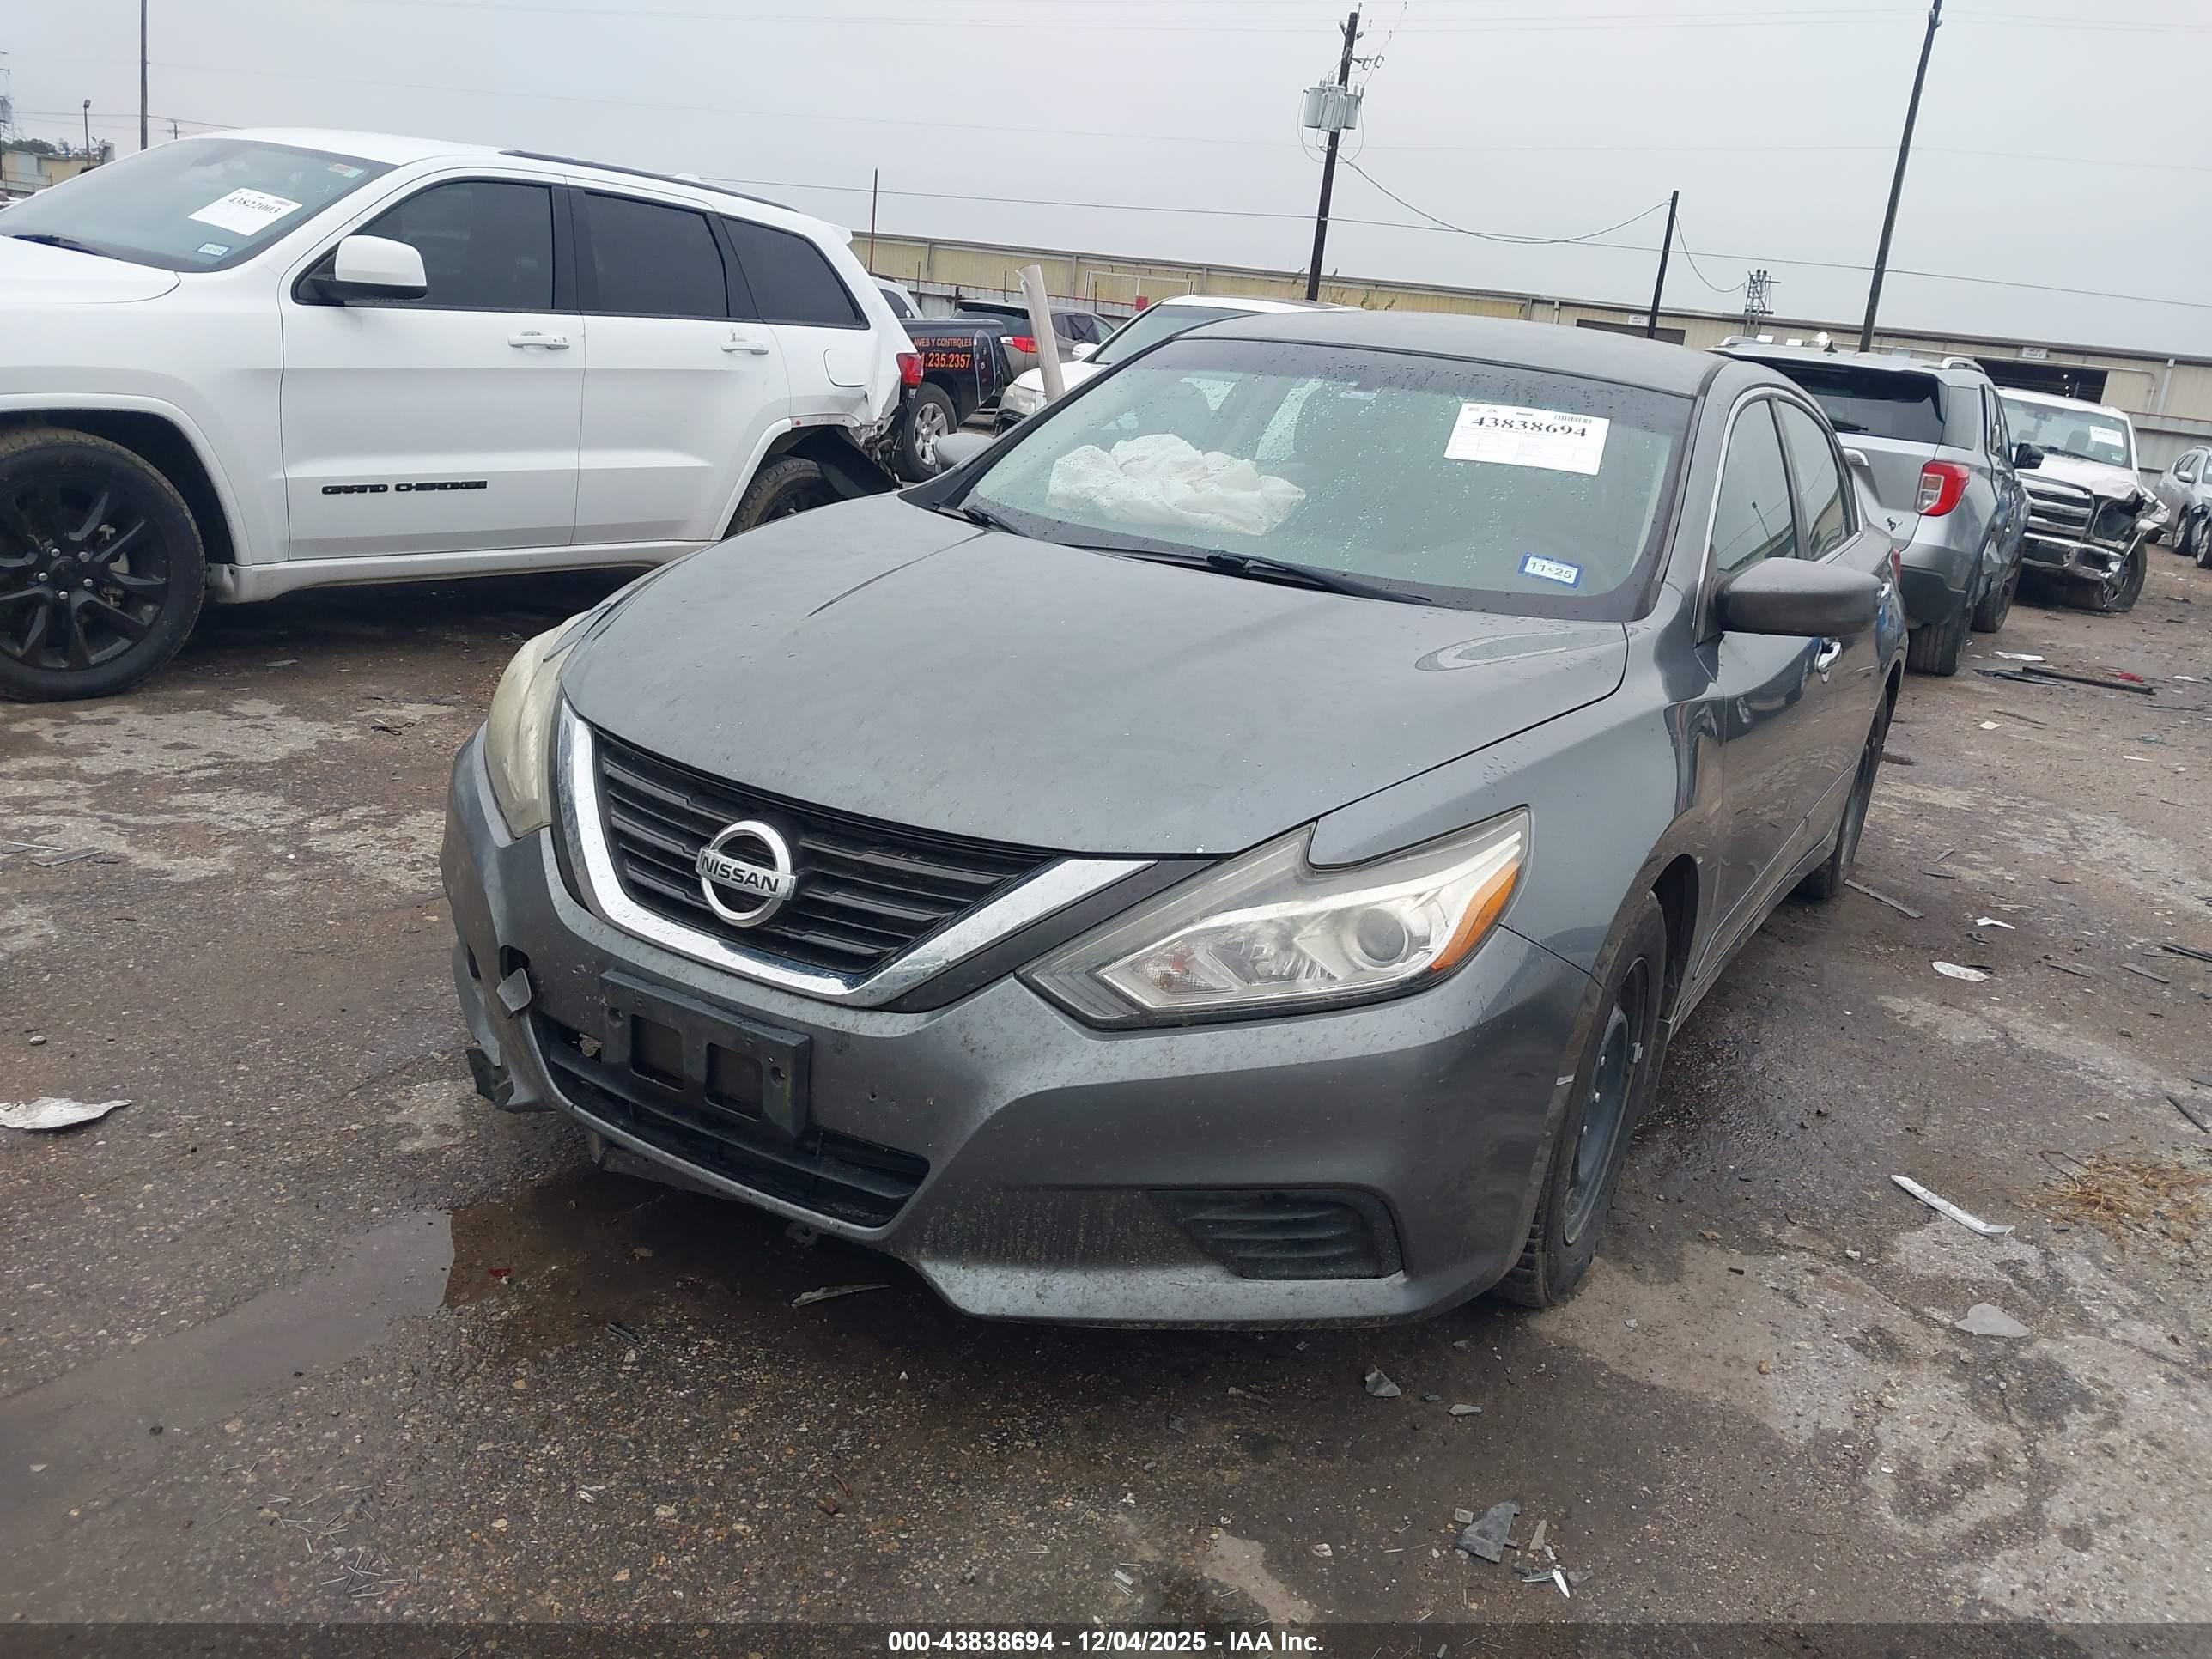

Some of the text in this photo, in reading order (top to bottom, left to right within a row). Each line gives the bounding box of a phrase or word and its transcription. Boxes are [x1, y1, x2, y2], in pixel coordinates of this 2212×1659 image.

[931, 337, 936, 347] Y
[937, 337, 972, 348] CONTROLES
[1471, 416, 1588, 437] 43838694
[701, 855, 780, 893] NISSAN
